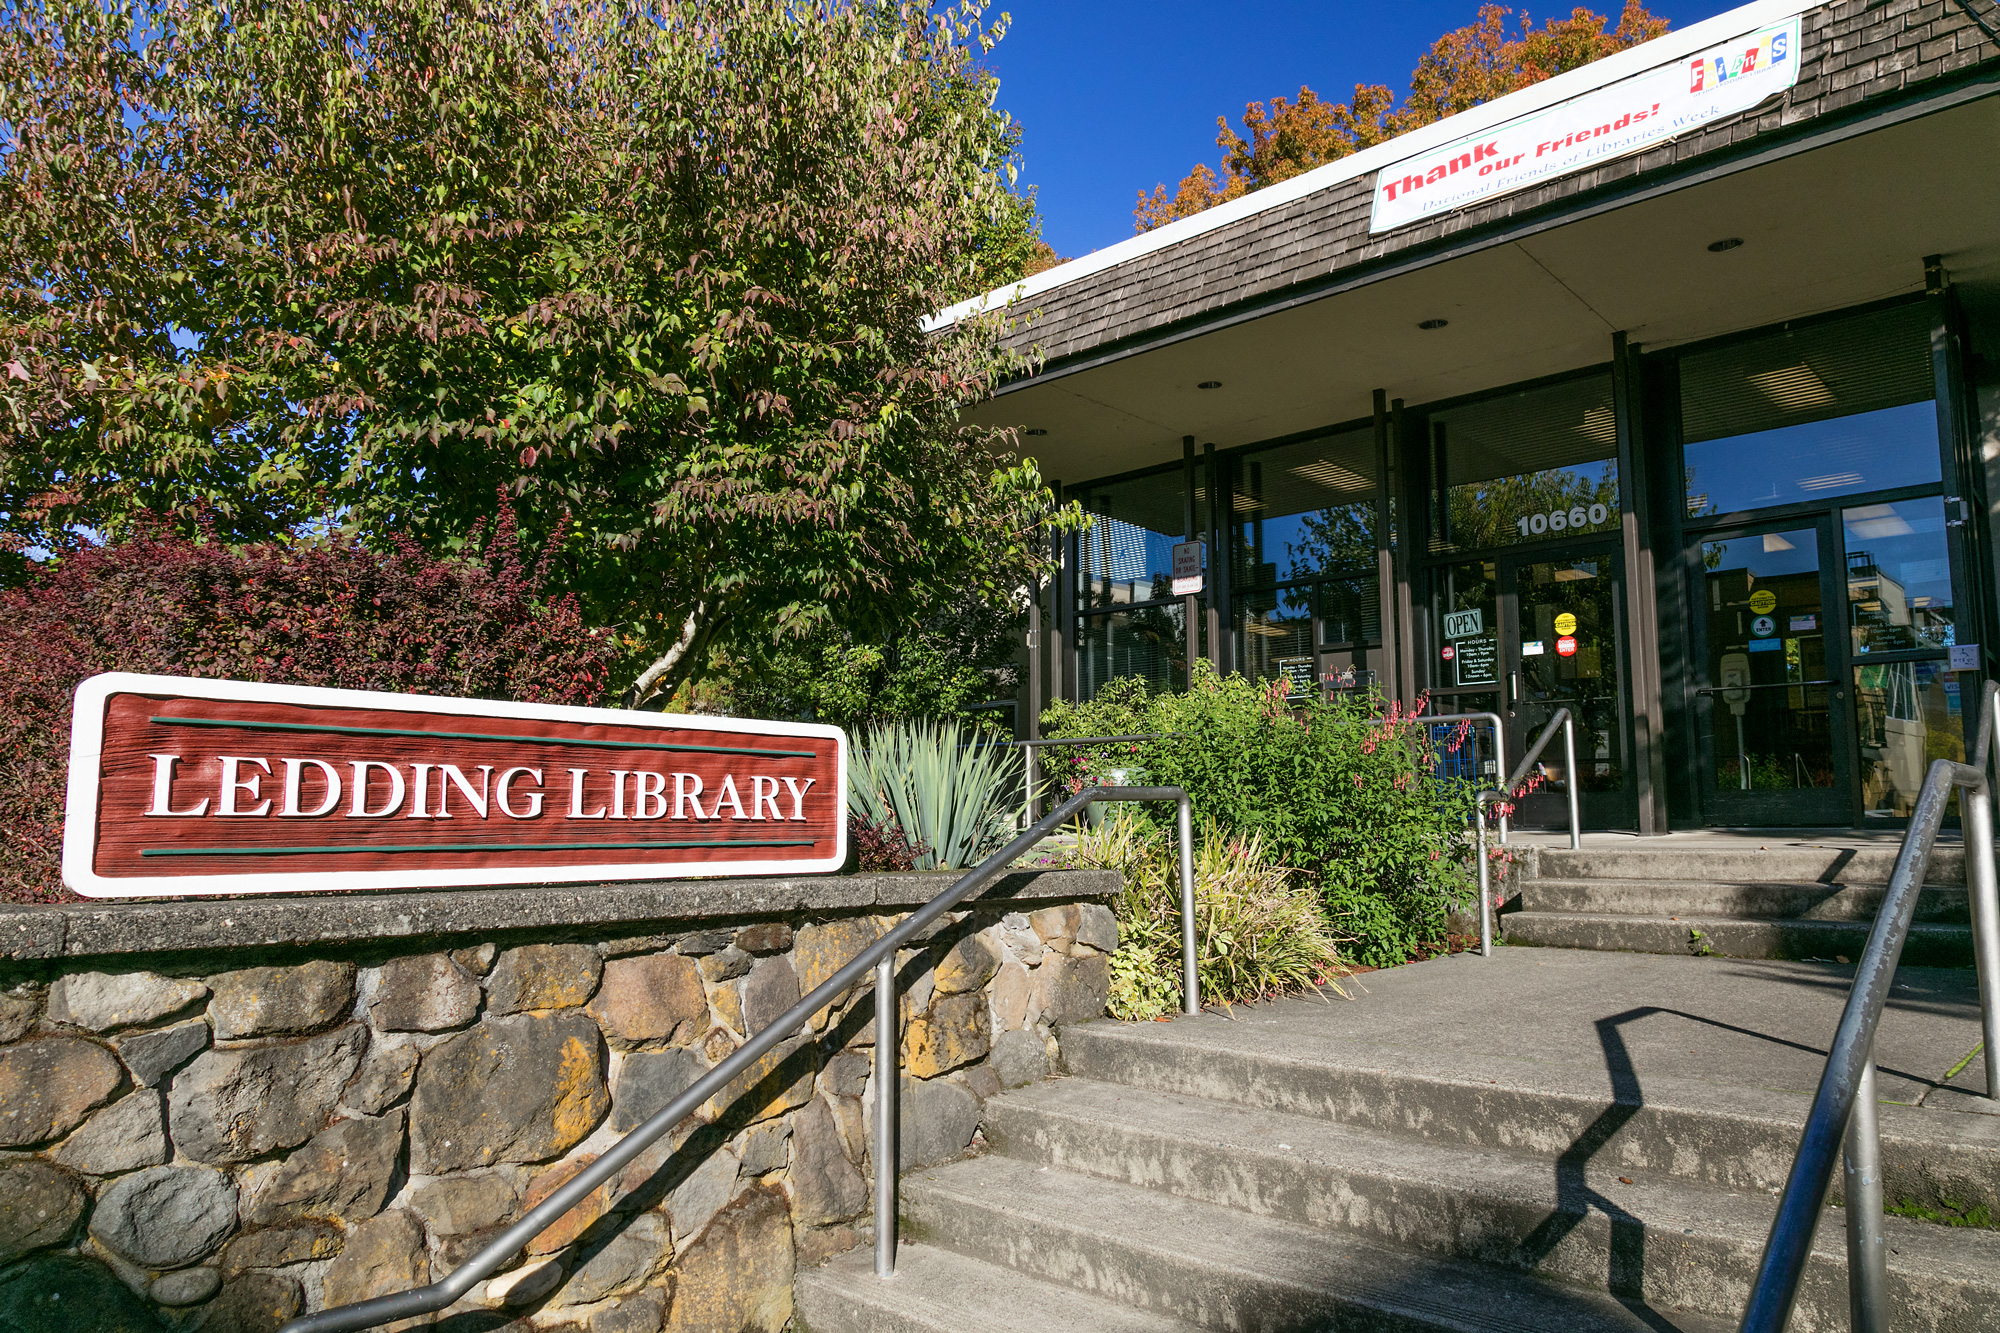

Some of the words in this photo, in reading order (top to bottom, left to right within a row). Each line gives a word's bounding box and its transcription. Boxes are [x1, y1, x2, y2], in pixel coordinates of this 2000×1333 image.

[1479, 153, 1525, 176] our
[1536, 103, 1660, 157] Friends!
[1497, 163, 1556, 188] Friends
[1562, 151, 1582, 165] of
[1586, 124, 1665, 158] Libraries
[1672, 105, 1720, 127] Week
[1382, 140, 1499, 202] Thank
[1517, 503, 1608, 537] 10660
[1178, 556, 1195, 564] SKATING
[1447, 612, 1479, 636] OPEN
[144, 754, 545, 819] LEDDING
[565, 768, 817, 821] LIBRARY
